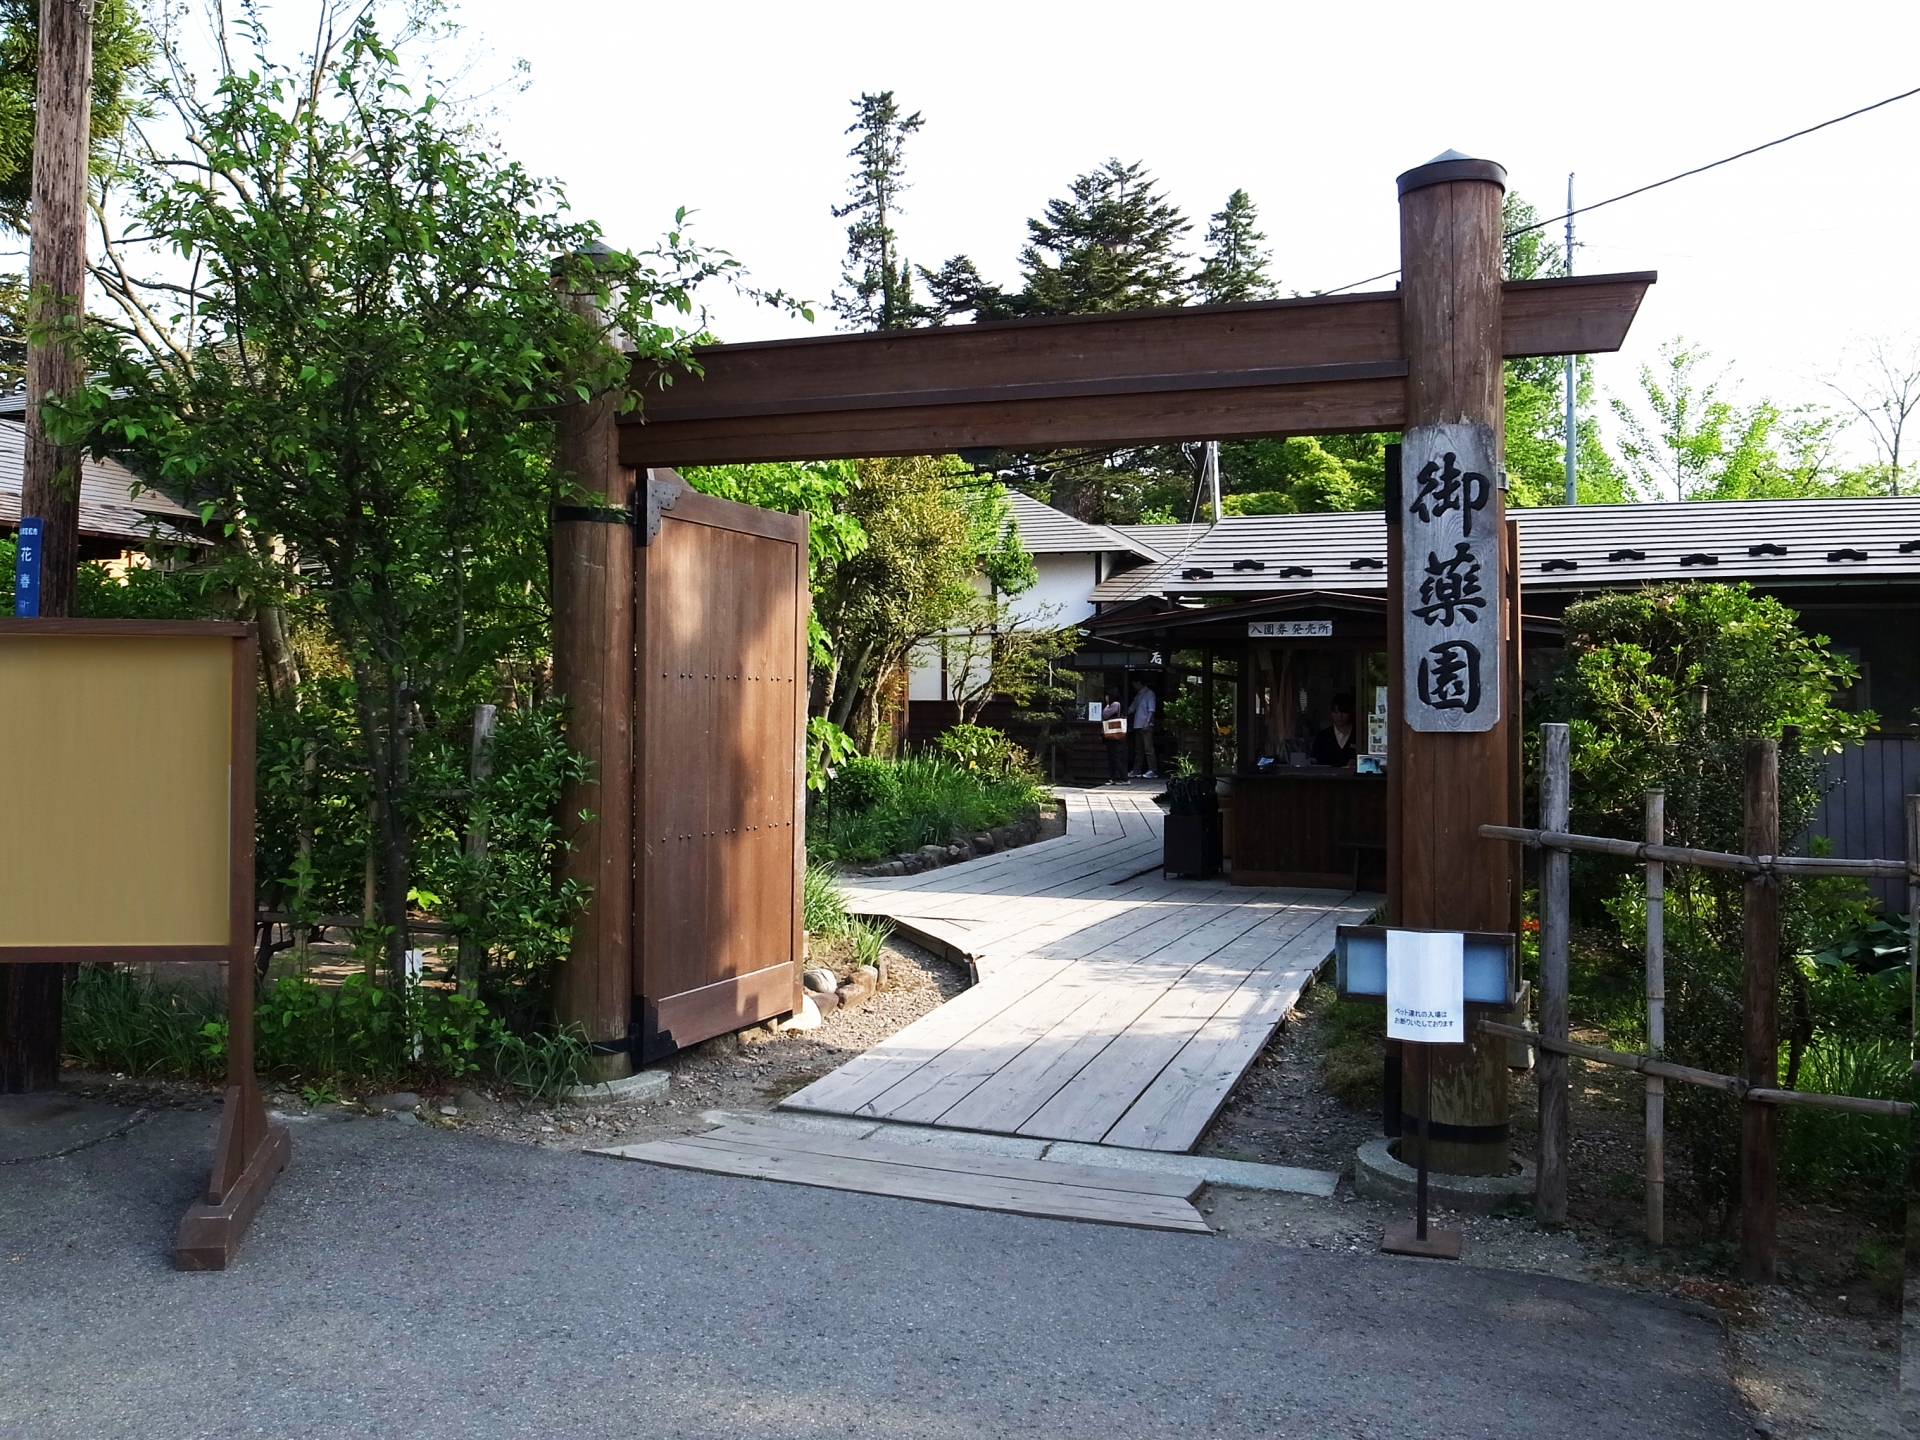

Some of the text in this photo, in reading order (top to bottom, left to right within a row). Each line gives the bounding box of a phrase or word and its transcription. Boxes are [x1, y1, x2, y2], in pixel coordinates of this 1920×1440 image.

[1394, 1017, 1454, 1027] お断りいたしております
